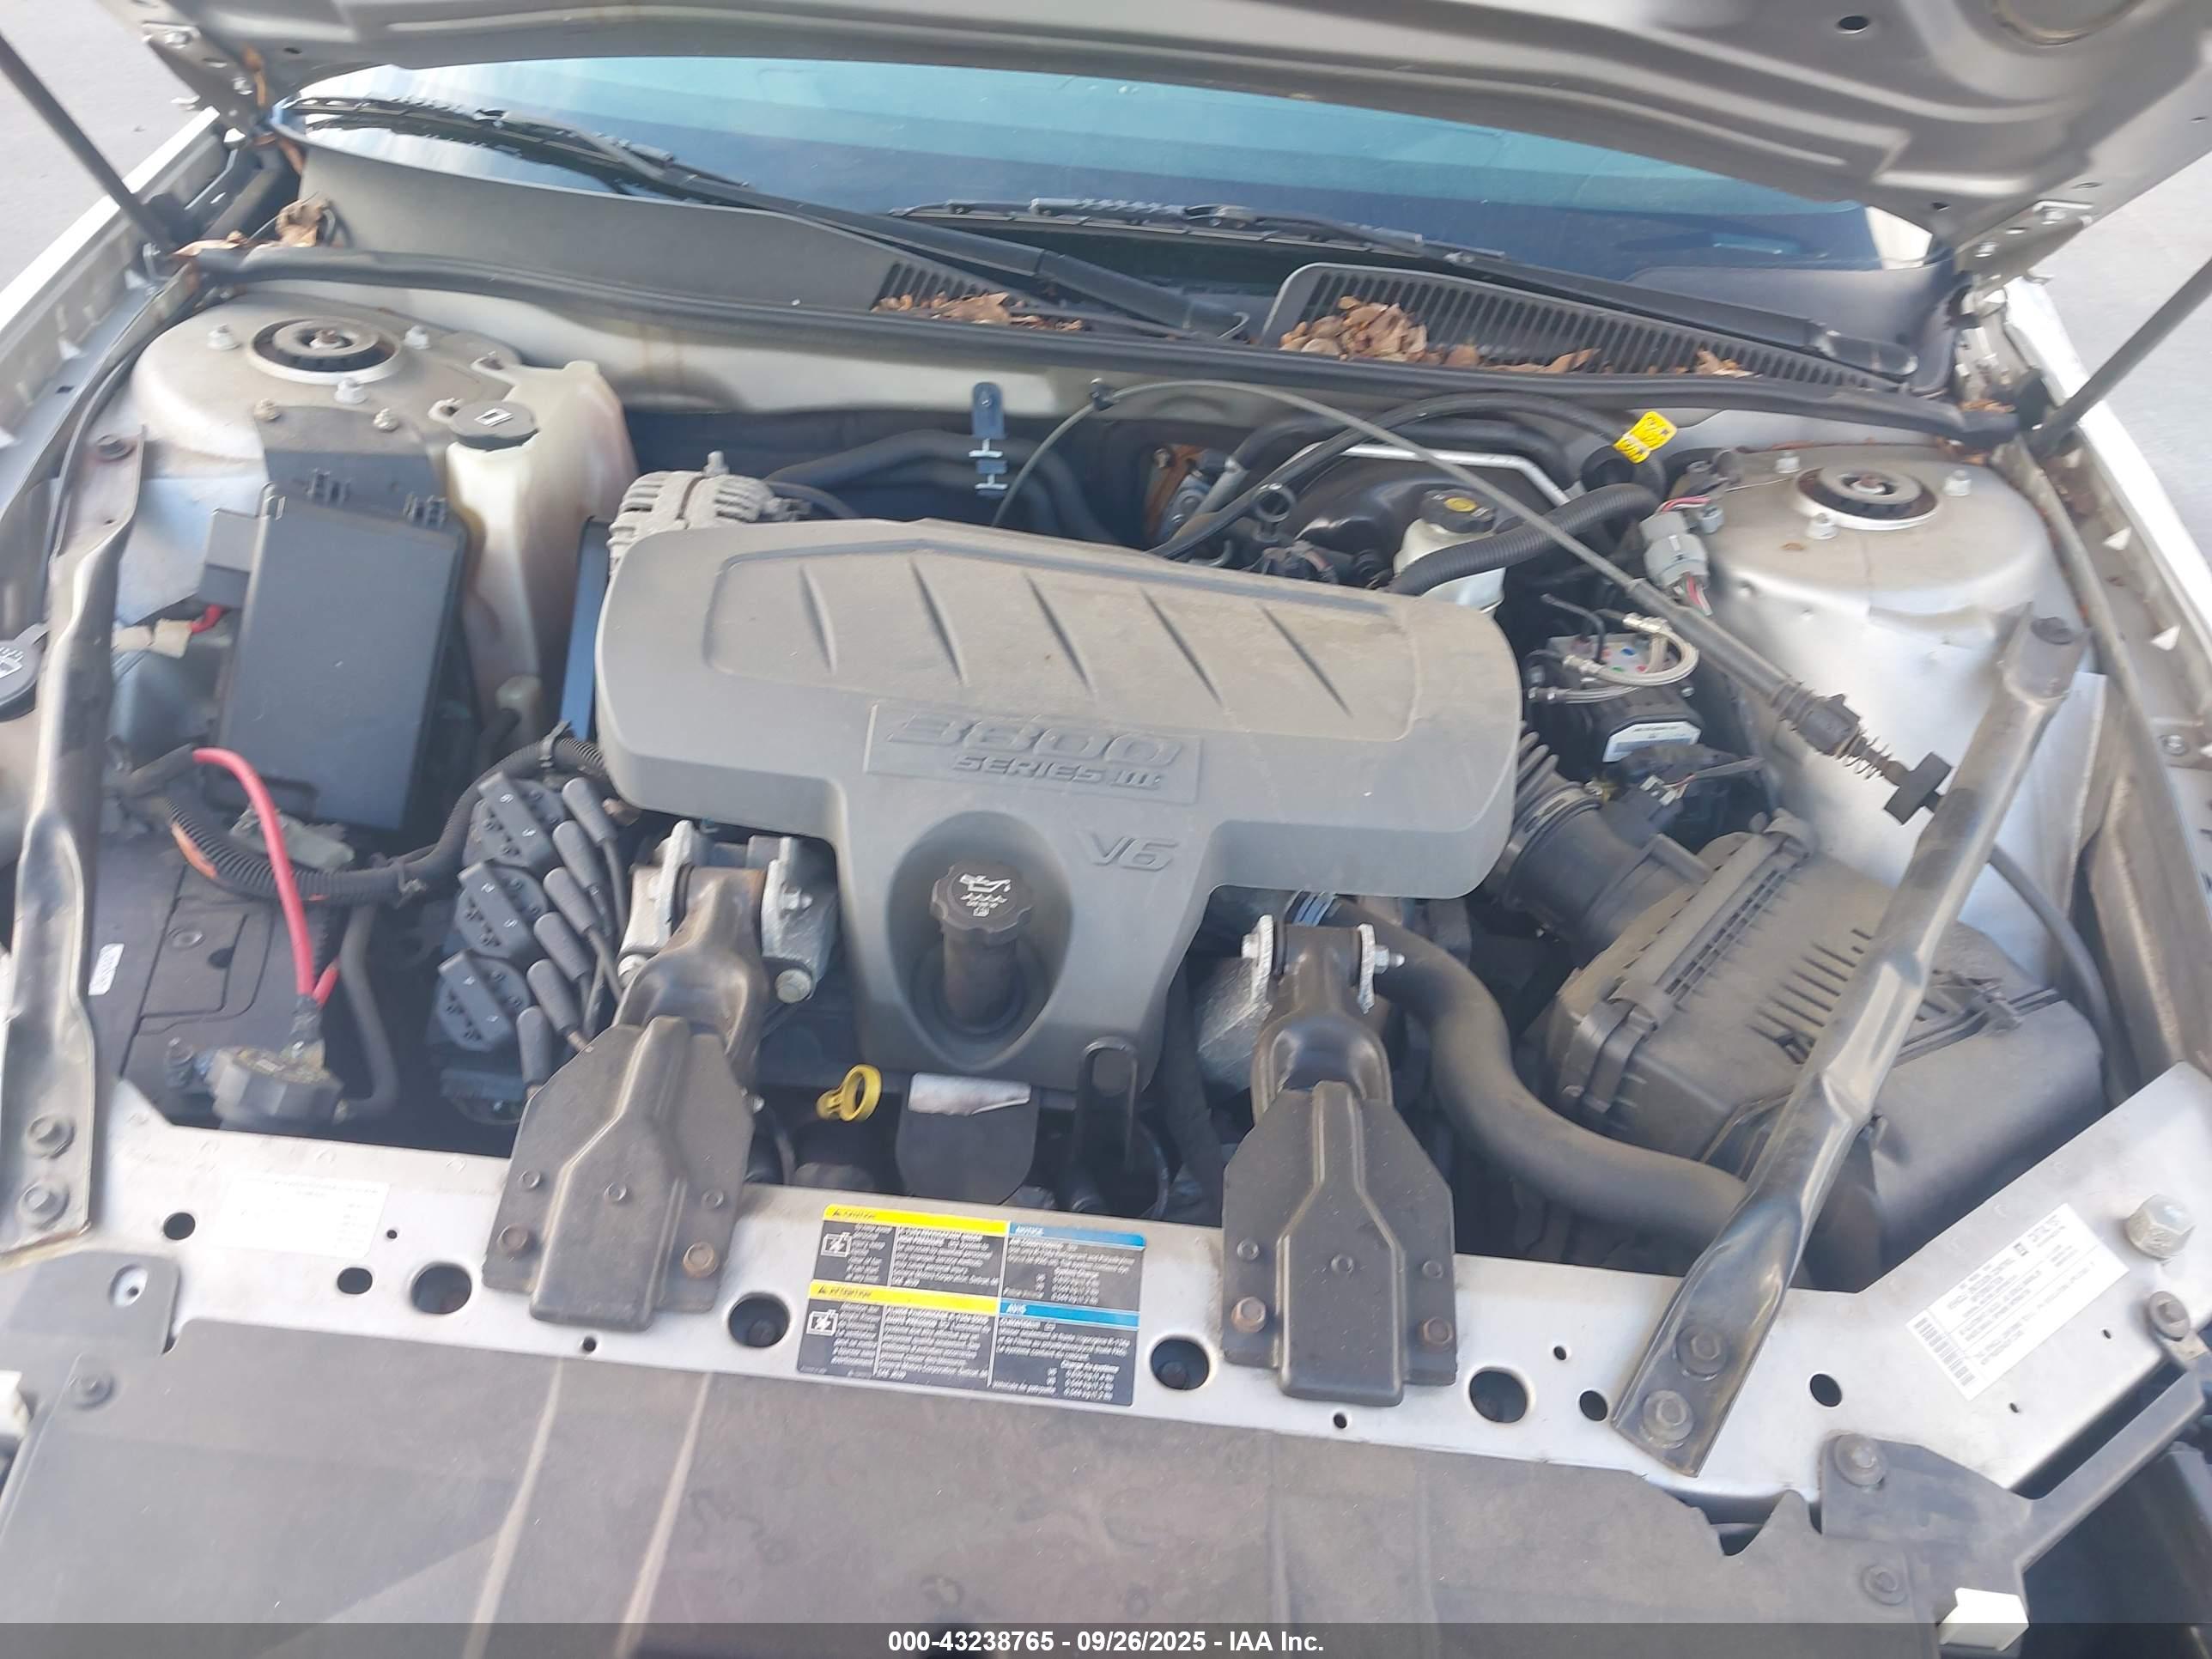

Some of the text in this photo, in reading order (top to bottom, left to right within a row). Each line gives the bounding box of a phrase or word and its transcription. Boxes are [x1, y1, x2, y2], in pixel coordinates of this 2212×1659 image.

[887, 712, 1182, 767] 3800
[952, 755, 1106, 783] SERIES
[1079, 830, 1179, 872] V6
